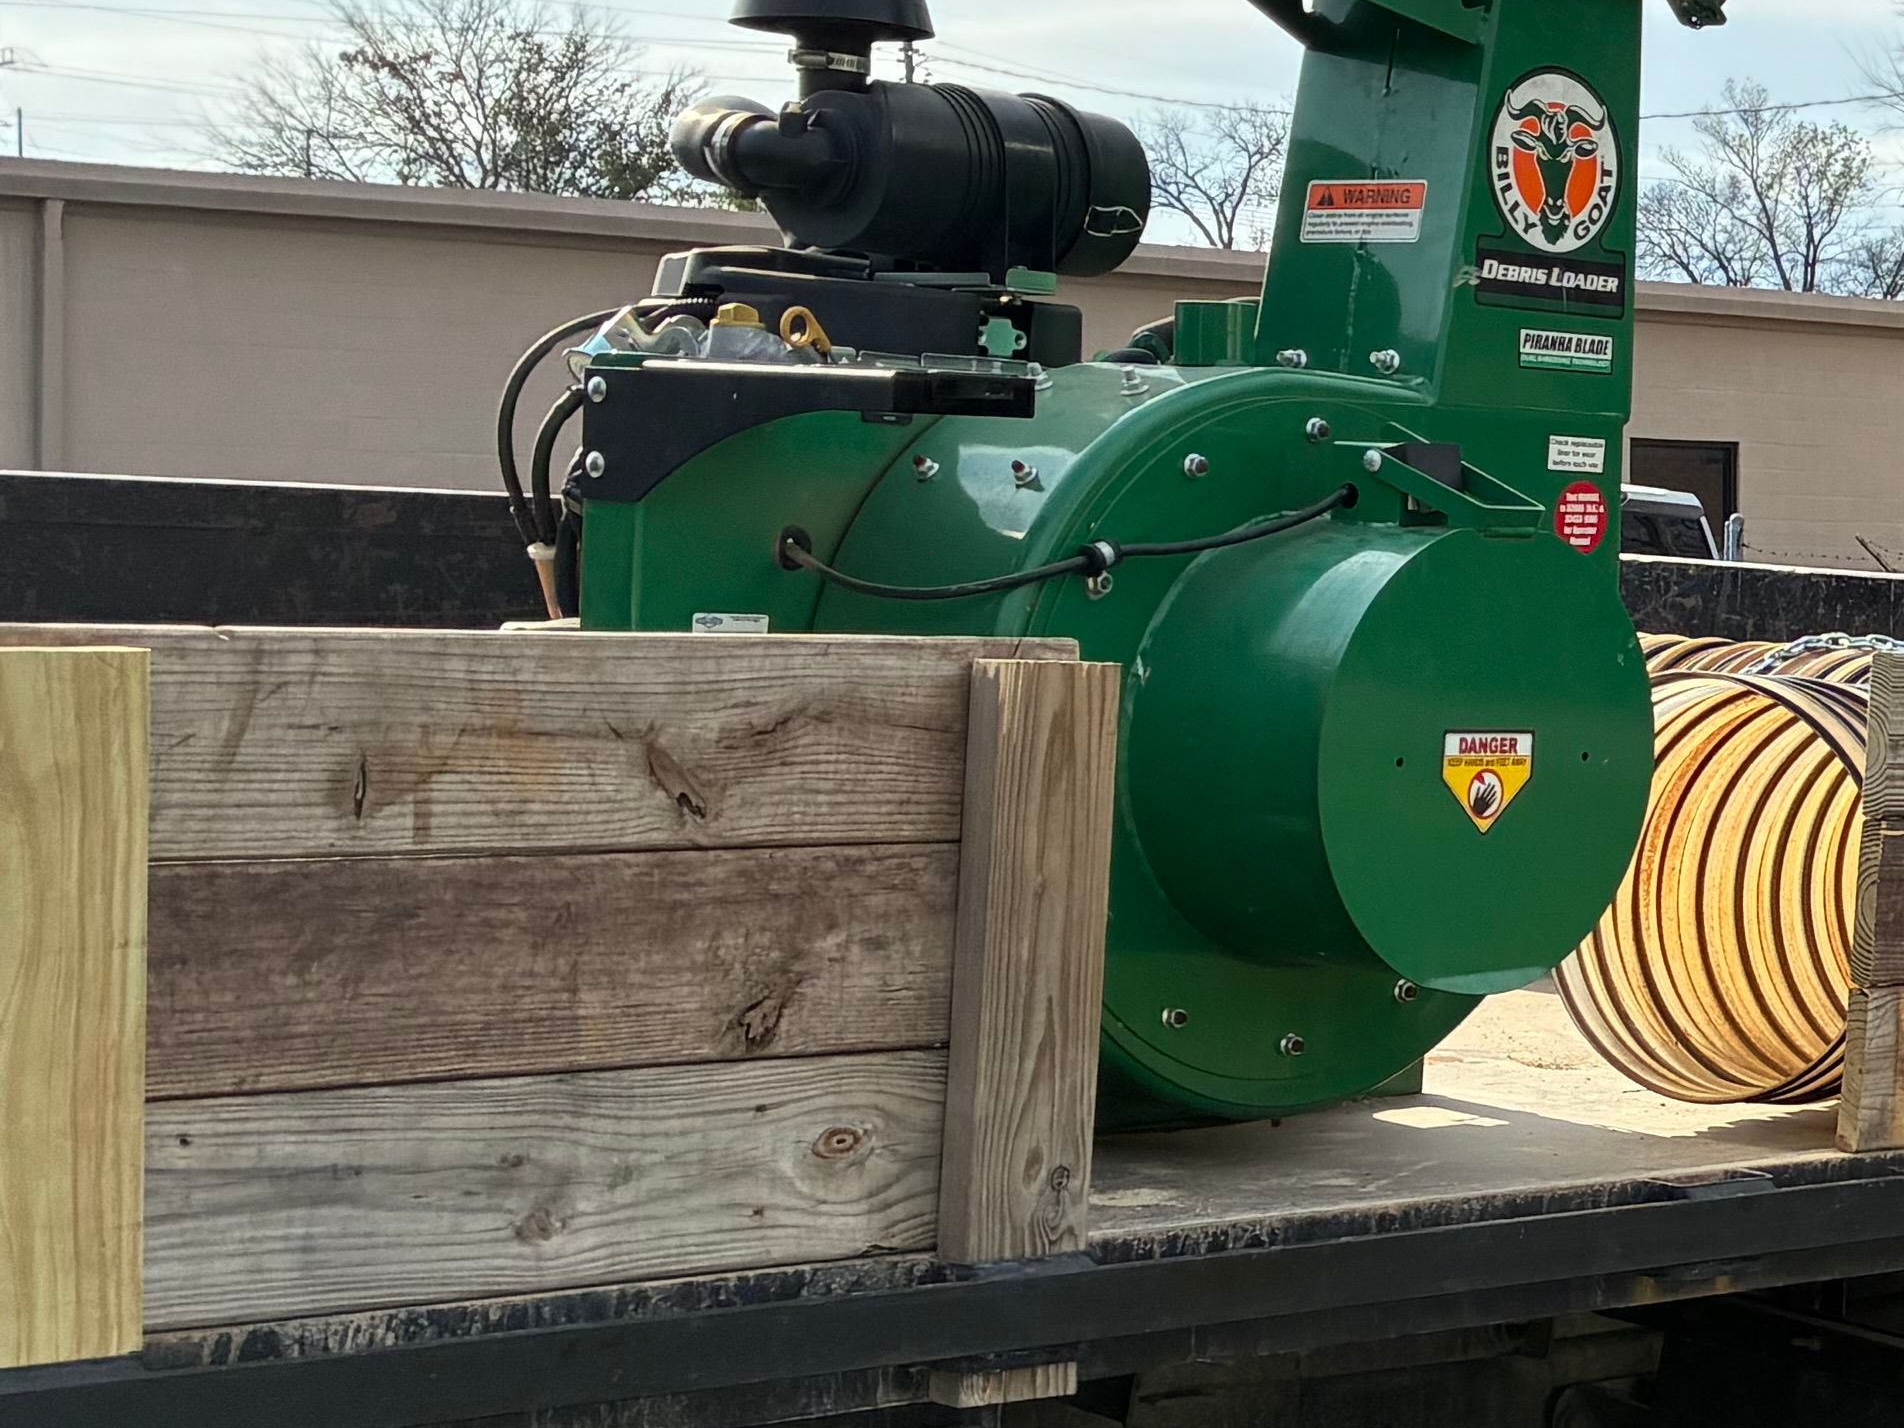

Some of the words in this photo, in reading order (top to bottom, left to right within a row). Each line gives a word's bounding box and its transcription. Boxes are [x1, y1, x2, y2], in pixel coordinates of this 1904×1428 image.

[1343, 188, 1411, 204] WARNING
[1496, 146, 1539, 235] BILLY
[1573, 160, 1613, 241] GOAT
[1481, 258, 1549, 285] DEBRIS
[1549, 267, 1619, 293] LOADER
[1522, 332, 1572, 353] PIRANHA
[1573, 338, 1609, 356] BLADE
[1458, 737, 1518, 754] DANGER
